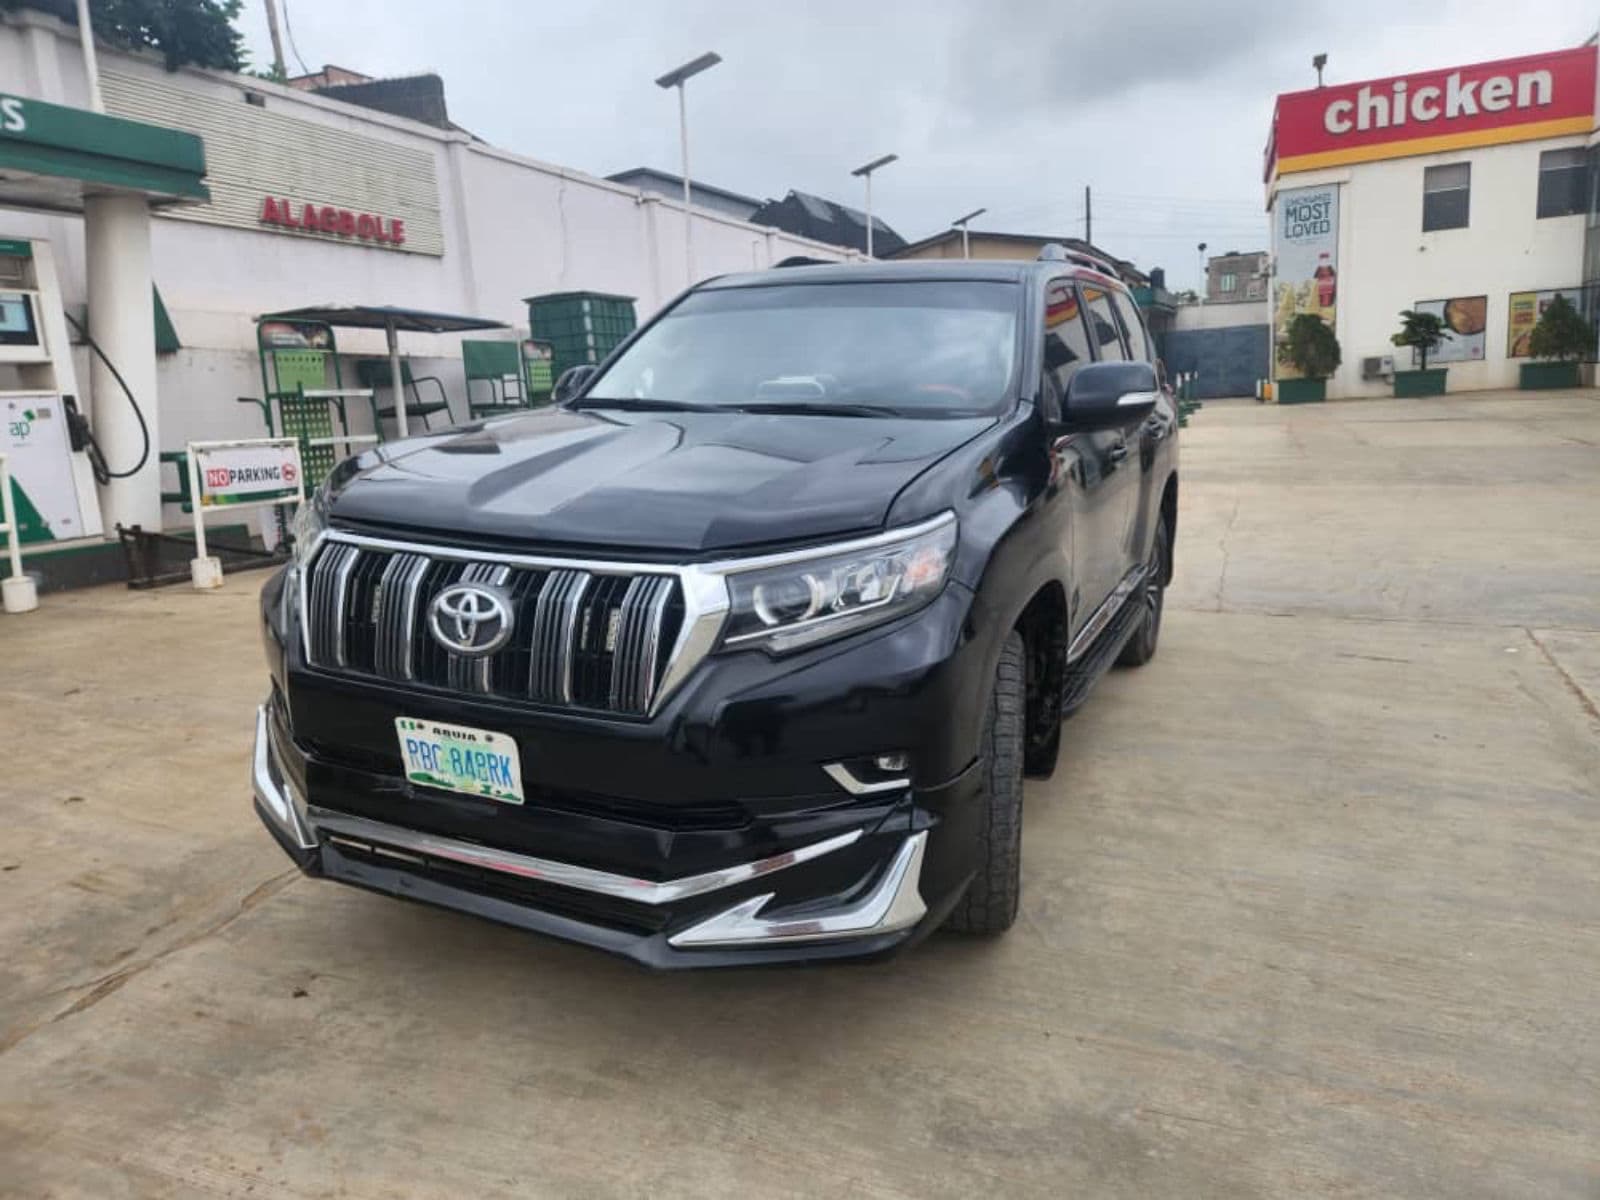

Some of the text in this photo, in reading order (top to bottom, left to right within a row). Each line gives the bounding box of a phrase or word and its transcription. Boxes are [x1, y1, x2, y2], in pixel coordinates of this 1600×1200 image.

[1324, 69, 1553, 134] chicken
[0, 98, 25, 131] S
[261, 195, 406, 244] ALAGBOLE
[1286, 201, 1331, 223] MOST
[1285, 220, 1330, 239] LOVED
[207, 466, 280, 487] NO PARKING
[432, 727, 477, 741] ABUJA
